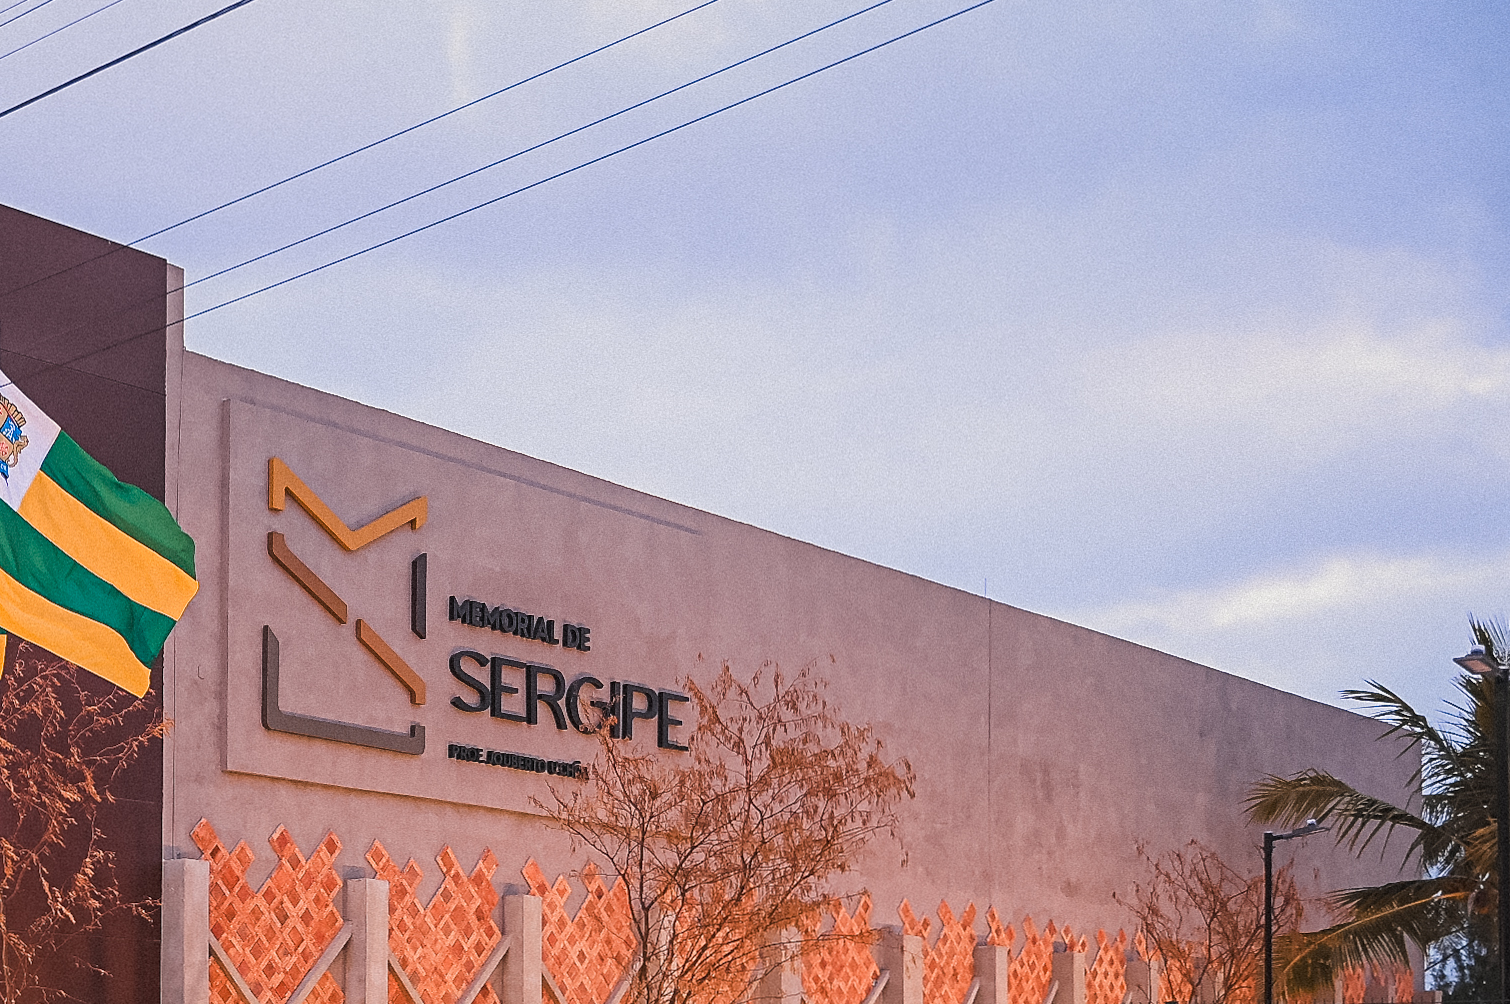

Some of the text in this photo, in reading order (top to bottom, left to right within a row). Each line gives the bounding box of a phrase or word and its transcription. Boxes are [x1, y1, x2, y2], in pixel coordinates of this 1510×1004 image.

[448, 595, 591, 652] MEMORIAL DE
[448, 650, 691, 752] SERGIPE
[485, 750, 546, 774] JOUBERTO
